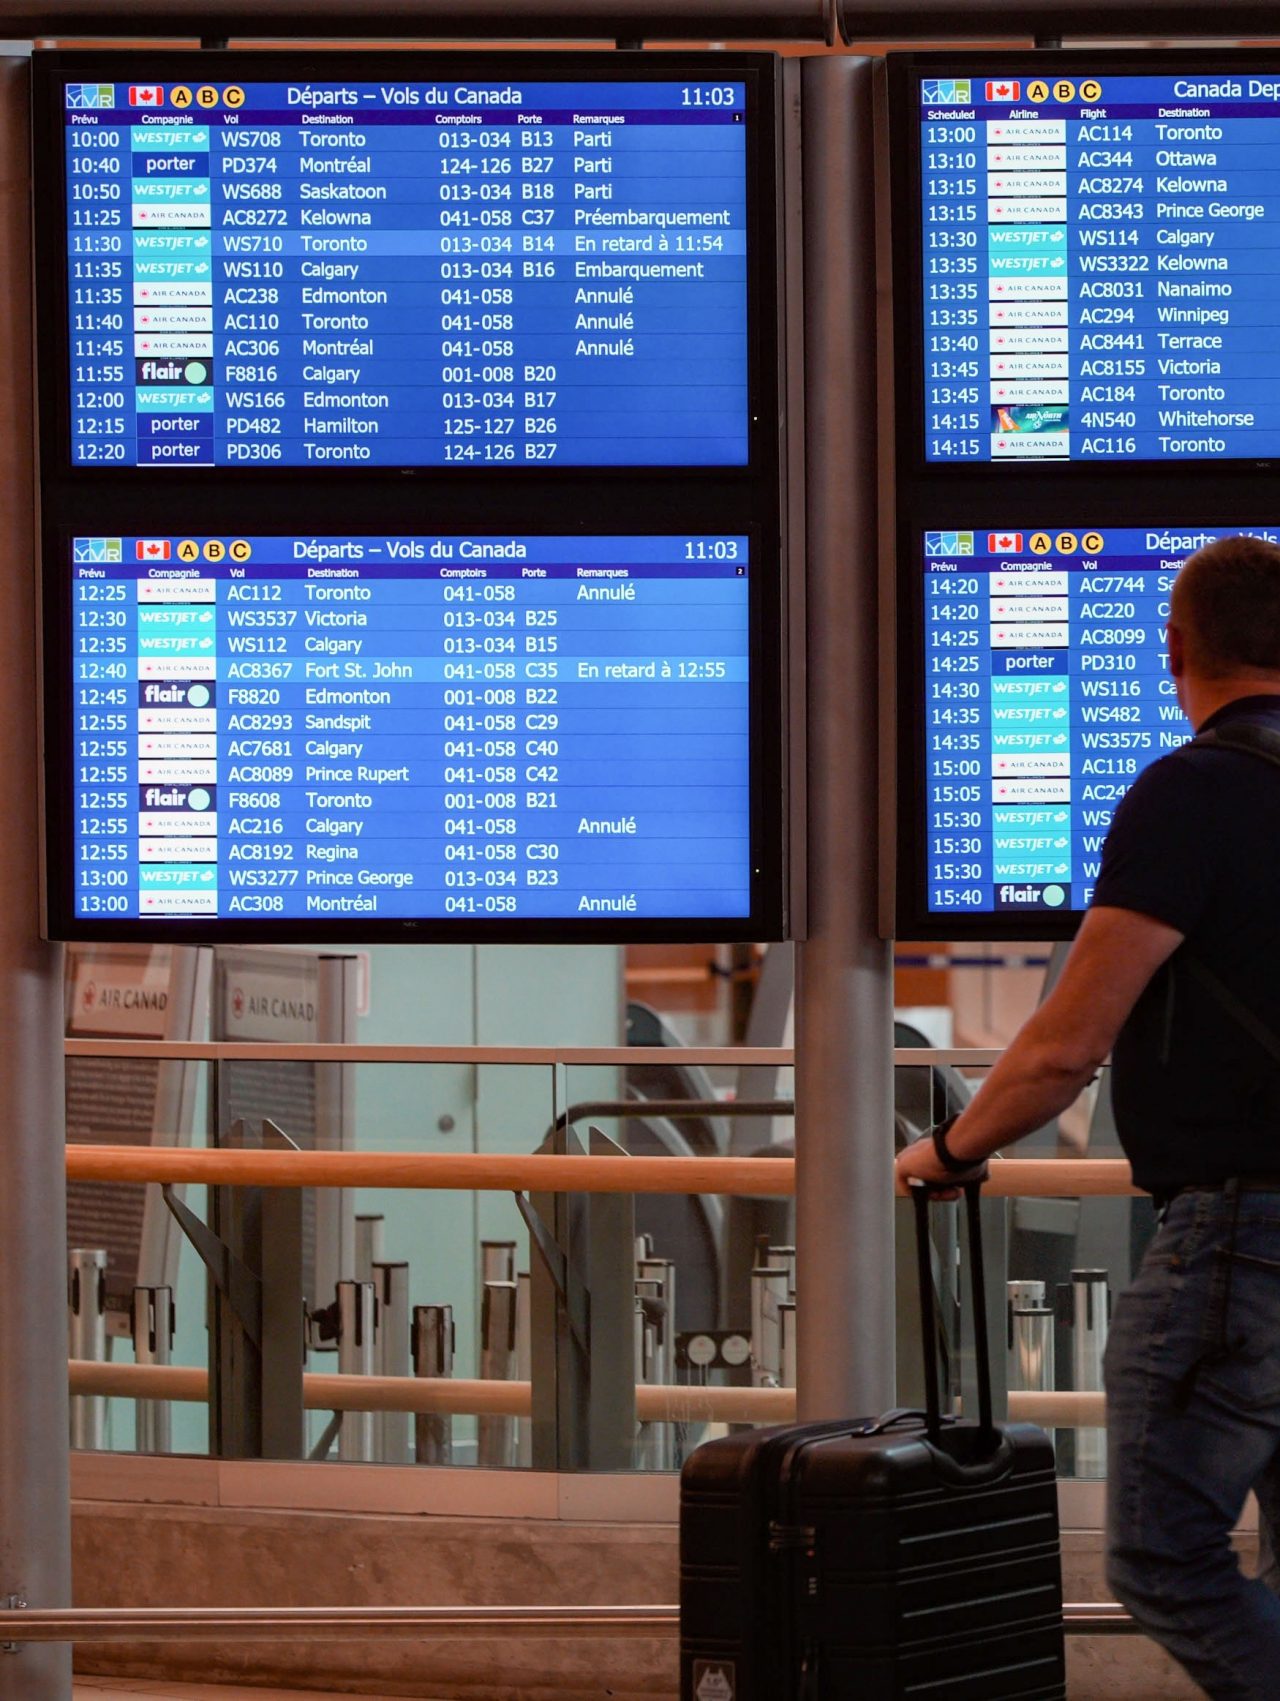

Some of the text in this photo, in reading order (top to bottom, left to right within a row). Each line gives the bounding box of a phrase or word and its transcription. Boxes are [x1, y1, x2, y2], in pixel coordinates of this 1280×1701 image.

[176, 86, 734, 108] A B C Départs Vols du Canada 11:03
[1174, 80, 1241, 97] Canada
[68, 95, 112, 108] YVR
[72, 114, 624, 125] Prévu Compagnie Vol Destination Comptoirs Porte Remarques
[928, 110, 975, 119] Scheduled
[1009, 110, 1038, 118] Airline
[1081, 109, 1106, 119] Flight
[1159, 108, 1210, 117] Destination
[73, 131, 611, 148] 10:00 WESTJET WS708 Toronto 013-034 B13 Parti
[929, 127, 975, 142] 13:00
[1078, 126, 1132, 141] AC114
[1155, 125, 1222, 140] Toronto
[74, 210, 120, 225] 11:25
[223, 210, 287, 225] AC8272
[301, 209, 371, 225] Kelowna
[440, 210, 511, 226] 041-058
[522, 210, 554, 225] C37
[575, 208, 730, 228] Préembarquement
[930, 205, 976, 221] 13:15
[1006, 206, 1024, 214] AIR
[1023, 206, 1061, 214] CANADA
[1079, 204, 1143, 219] AC8343
[1157, 203, 1203, 217] Prince
[1209, 203, 1264, 220] George
[77, 362, 556, 384] 11:55 flair F8816 Calgary 001-008 B20
[933, 414, 978, 429] 14:15
[1081, 412, 1135, 427] 4N540
[1159, 410, 1254, 426] Whitehorse
[80, 611, 557, 627] 12:30 WESTJET WS3537 Victoria 013-034 B25
[80, 663, 126, 678] 12:40
[228, 663, 292, 678] AC8367
[306, 663, 339, 678] Fort
[345, 663, 366, 678] St.
[373, 662, 412, 677] John
[444, 663, 515, 679] 041-058
[526, 663, 557, 677] C35
[579, 663, 598, 677] En
[606, 662, 655, 678] retard
[661, 661, 671, 677] à
[679, 662, 725, 677] 12:55
[933, 655, 1135, 672] 14:25 porter PD310
[933, 683, 979, 698] 14:30
[994, 683, 1050, 695] WESTJET
[1081, 681, 1140, 696] WS116
[934, 760, 980, 775] 15:00
[1082, 759, 1136, 774] AC118
[101, 988, 168, 1011] AIR CANAD
[248, 997, 317, 1022] AIR CANAD
